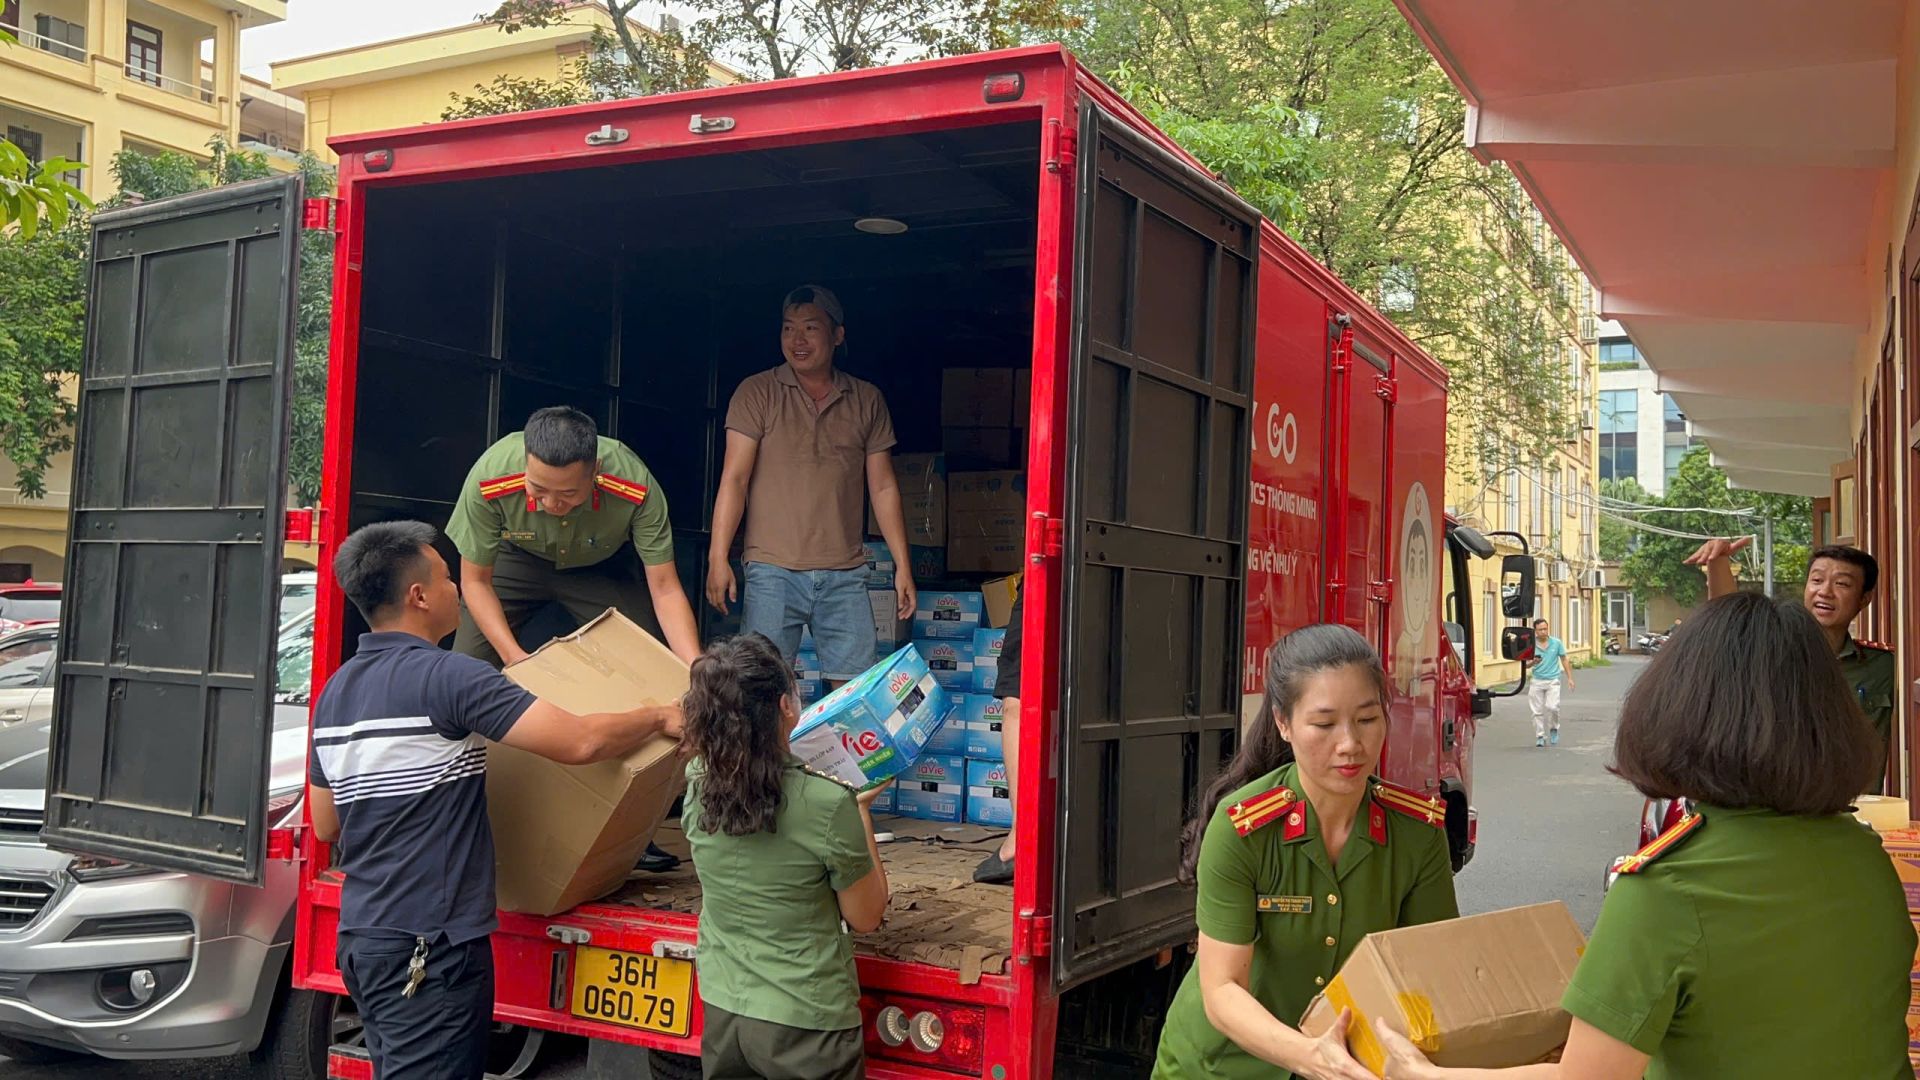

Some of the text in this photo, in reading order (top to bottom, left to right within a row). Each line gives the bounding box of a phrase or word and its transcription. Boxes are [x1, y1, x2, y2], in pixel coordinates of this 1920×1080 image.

[1250, 480, 1265, 506] ICS
[1296, 496, 1316, 520] MINH
[1248, 547, 1258, 570] NG
[607, 953, 658, 989] 36H
[584, 985, 675, 1028] 060.79
